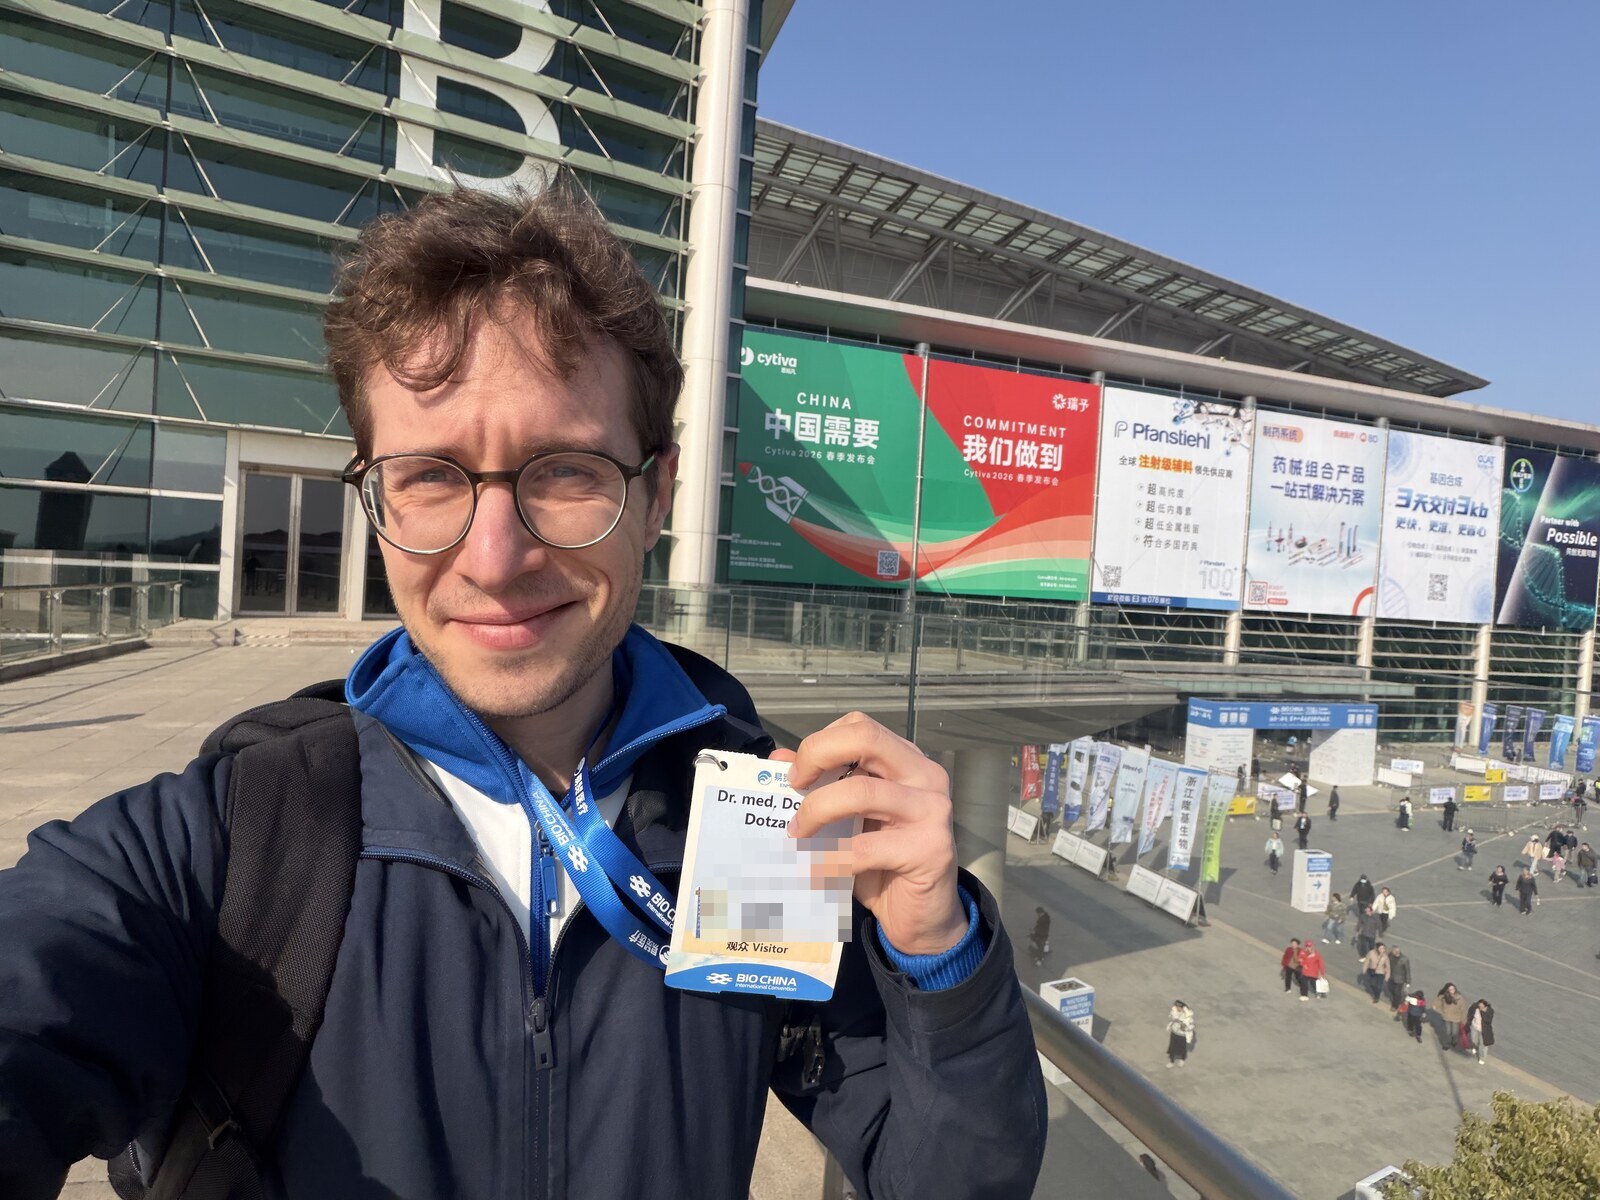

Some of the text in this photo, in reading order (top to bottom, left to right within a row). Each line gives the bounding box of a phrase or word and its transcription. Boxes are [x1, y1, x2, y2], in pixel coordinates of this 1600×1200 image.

[757, 353, 798, 367] cytiva
[797, 392, 852, 410] CHINA
[765, 408, 880, 450] 中国需要
[963, 415, 1066, 439] COMMITMENT
[1132, 423, 1211, 450] Pfanstiehl
[764, 446, 876, 465] Cytiva 2026 春季发布会
[963, 433, 1063, 472] 我们做到
[1119, 455, 1137, 467] 全球
[964, 468, 1059, 487] Cytiva 2026 春季发布会
[1273, 455, 1365, 484] 药械组合产品
[1271, 481, 1365, 507] 一站式解决方案
[1395, 488, 1488, 519] 3天交付3kb
[1541, 515, 1579, 527] Partner with
[1547, 527, 1598, 547] Possible
[717, 789, 737, 804] Dr.
[782, 797, 801, 811] Do
[745, 812, 790, 829] Dotza
[651, 892, 670, 913] BIO
[726, 941, 789, 954] 观众 Visitor
[735, 982, 797, 992] International Convention
[736, 973, 797, 987] BIO CHINA
